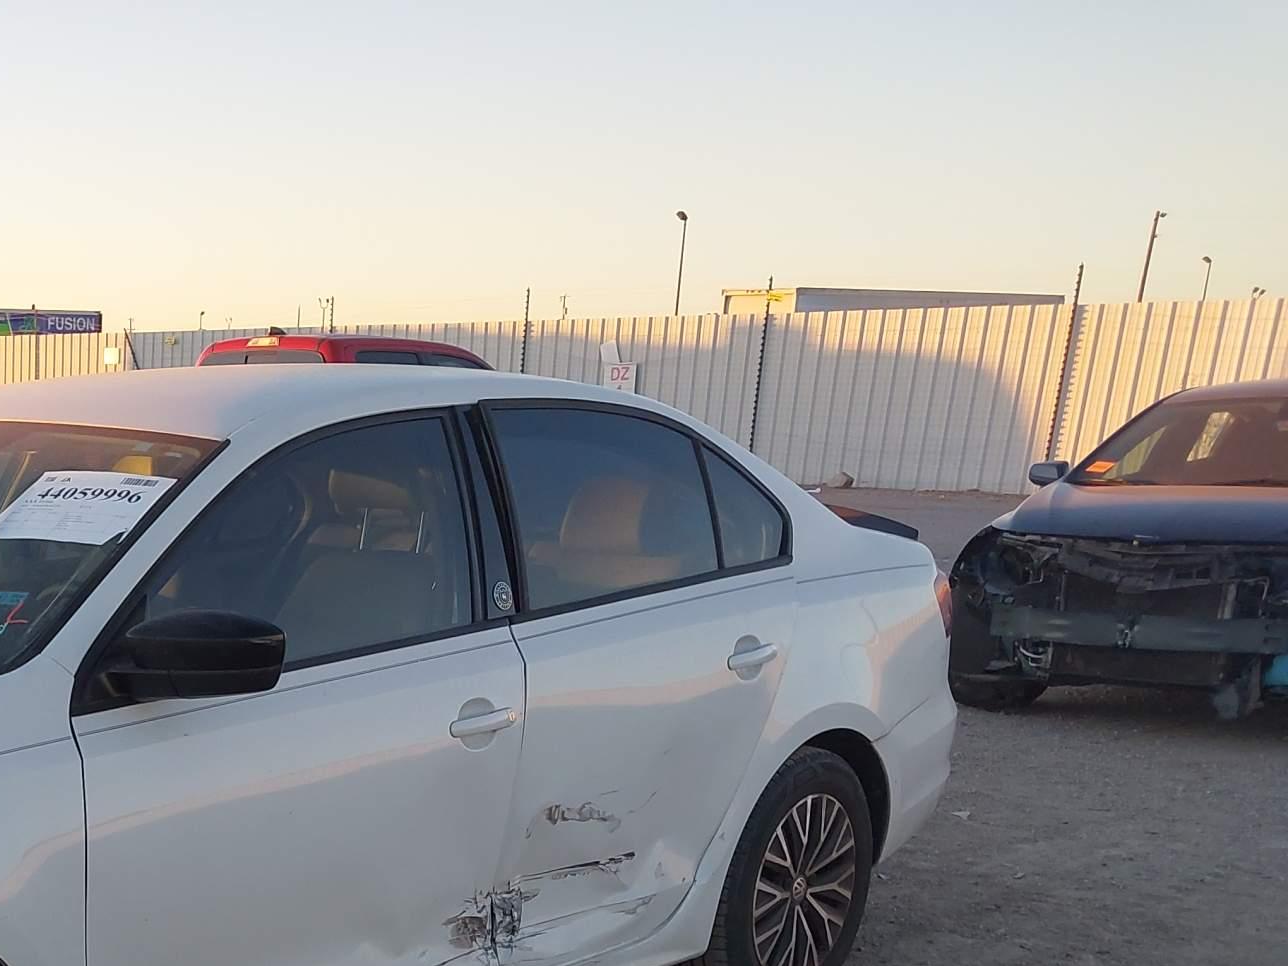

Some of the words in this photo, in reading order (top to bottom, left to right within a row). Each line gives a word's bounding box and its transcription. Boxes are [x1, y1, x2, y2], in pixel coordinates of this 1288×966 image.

[48, 317, 95, 331] FUSION
[611, 366, 631, 381] DZ
[37, 487, 146, 503] 44059996
